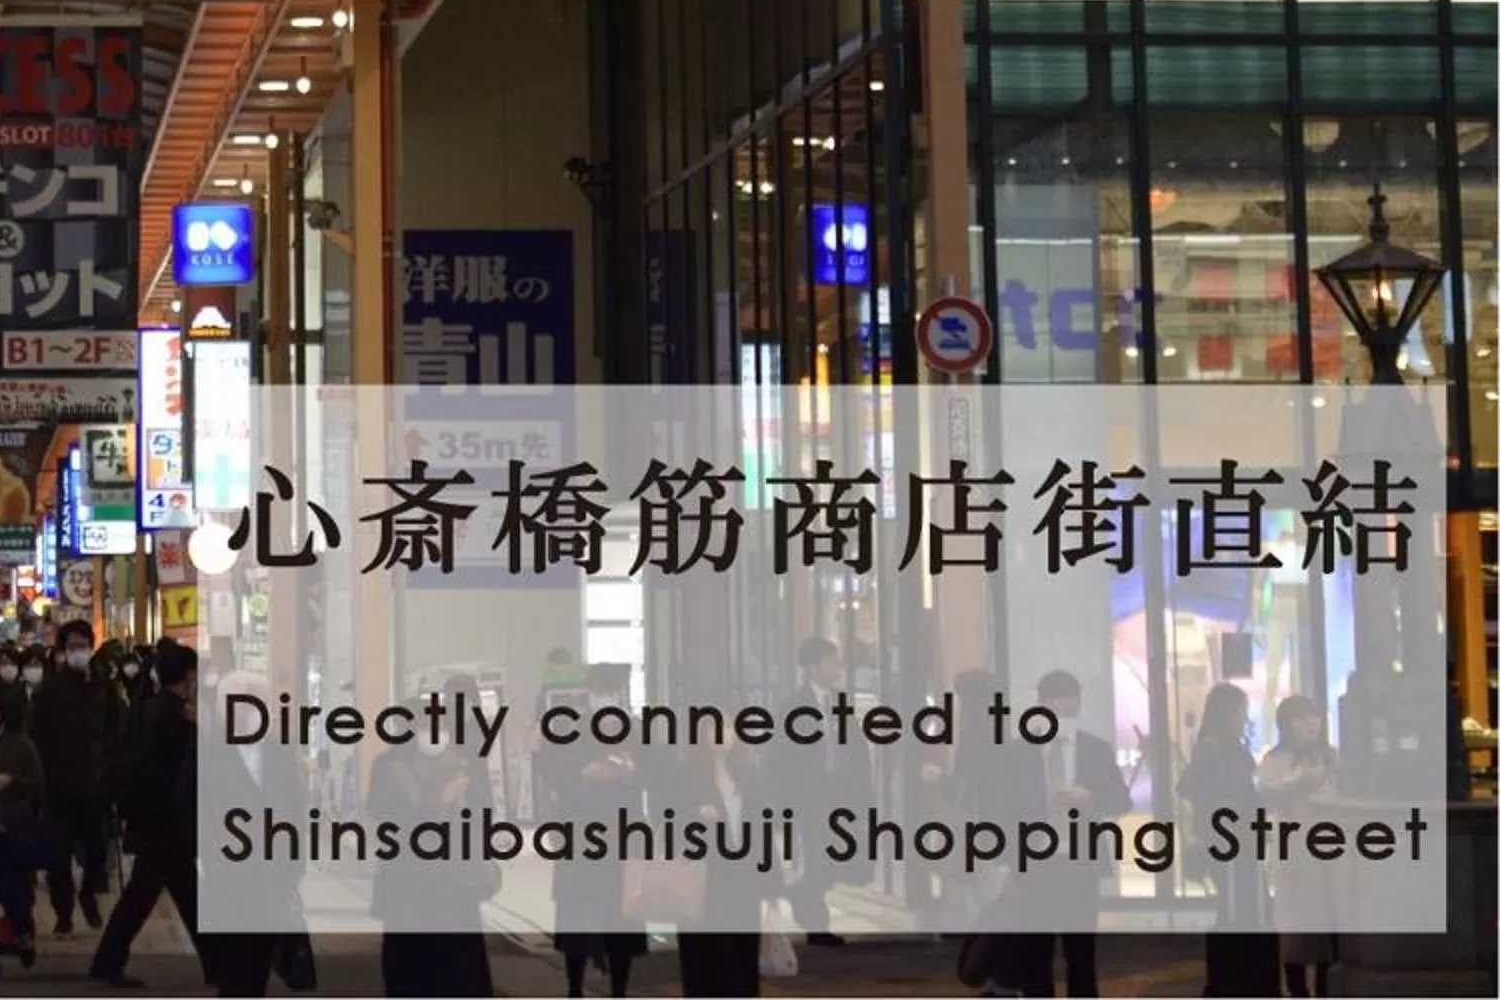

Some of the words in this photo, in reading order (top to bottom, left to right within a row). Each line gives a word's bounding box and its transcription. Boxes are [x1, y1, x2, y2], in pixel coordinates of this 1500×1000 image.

[403, 254, 550, 305] 洋服の
[403, 316, 555, 396] 青山
